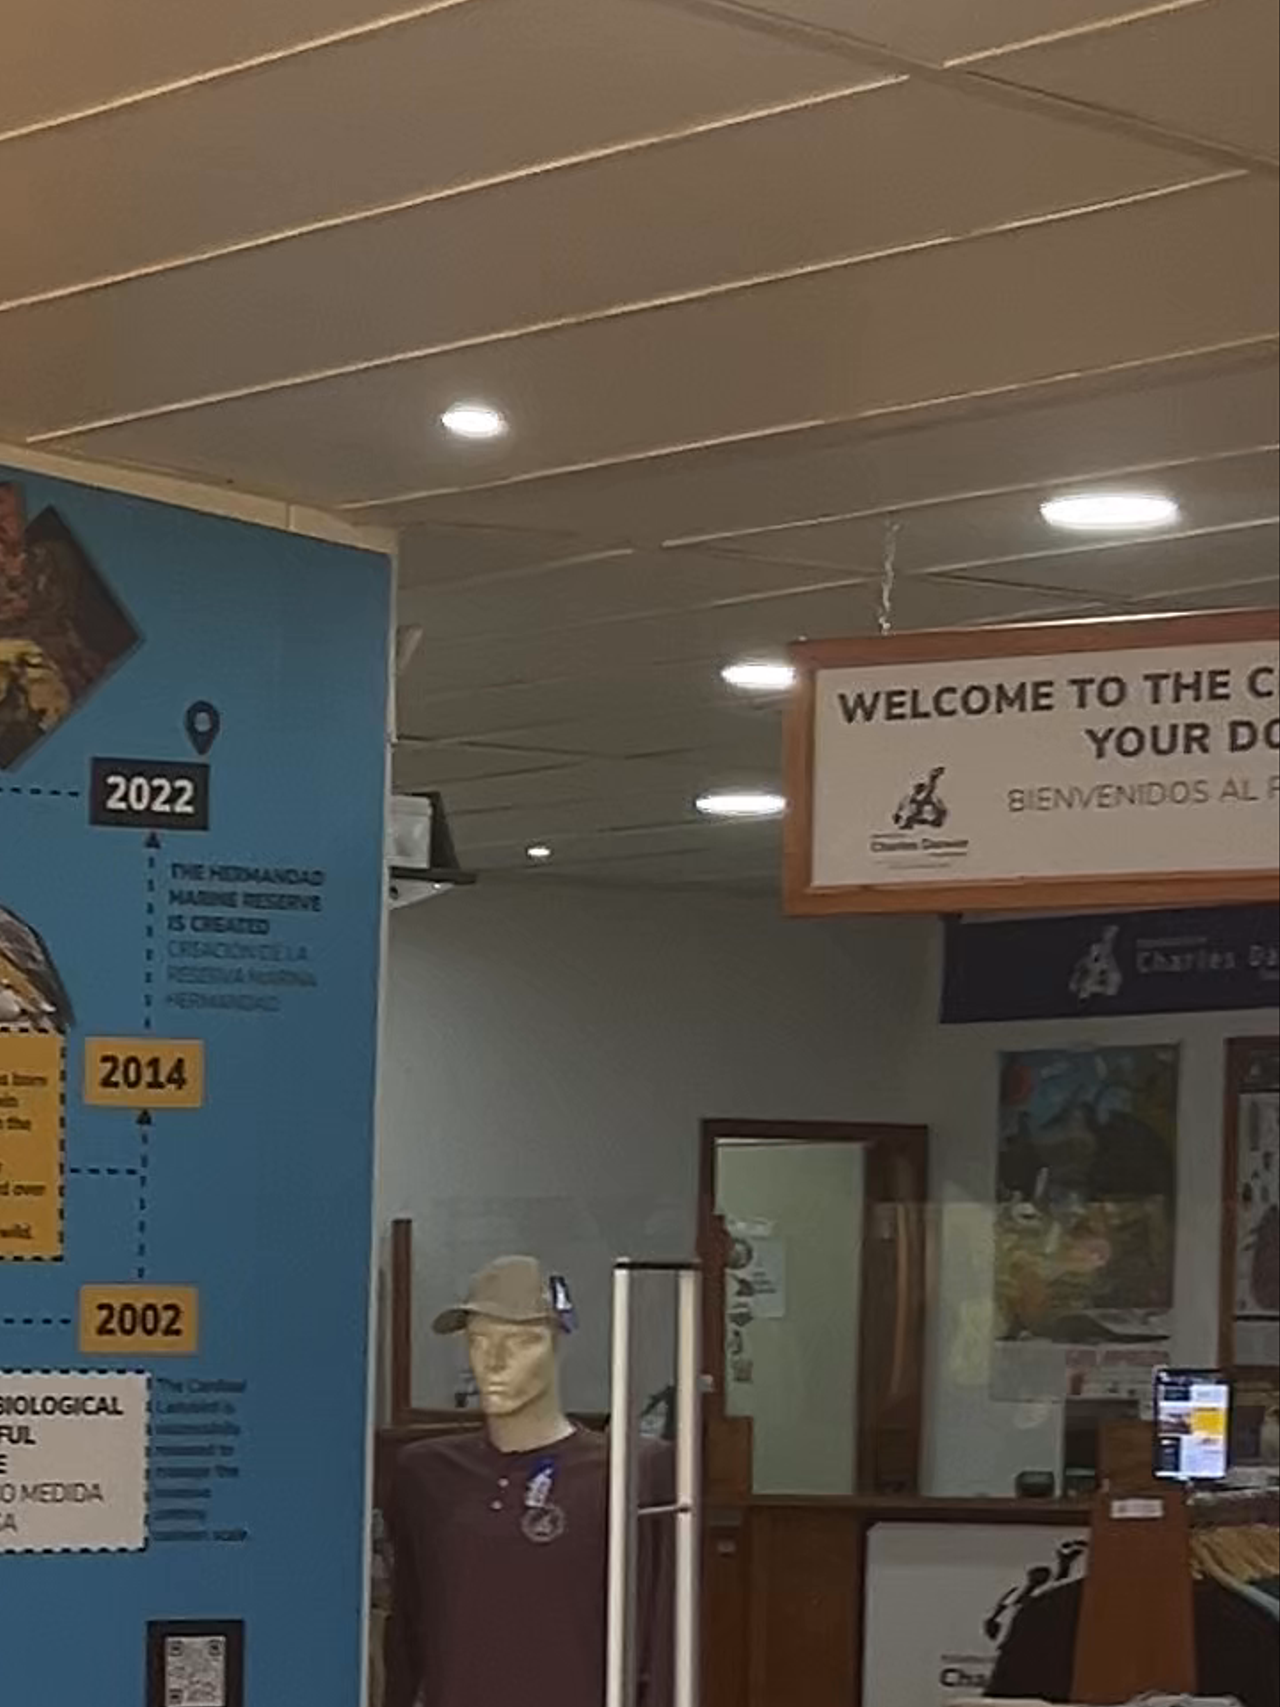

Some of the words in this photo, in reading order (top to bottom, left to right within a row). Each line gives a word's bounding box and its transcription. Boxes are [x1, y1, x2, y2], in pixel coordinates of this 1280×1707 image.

[838, 680, 1054, 724] WELCOME
[1068, 676, 1127, 709] TO
[1143, 669, 1231, 705] THE
[1085, 723, 1210, 759] YOUR
[107, 775, 193, 813] 2022
[1008, 779, 1209, 812] BIENVENIDOS
[1218, 776, 1259, 803] AL
[100, 1055, 186, 1090] 2014
[96, 1303, 181, 1337] 2002
